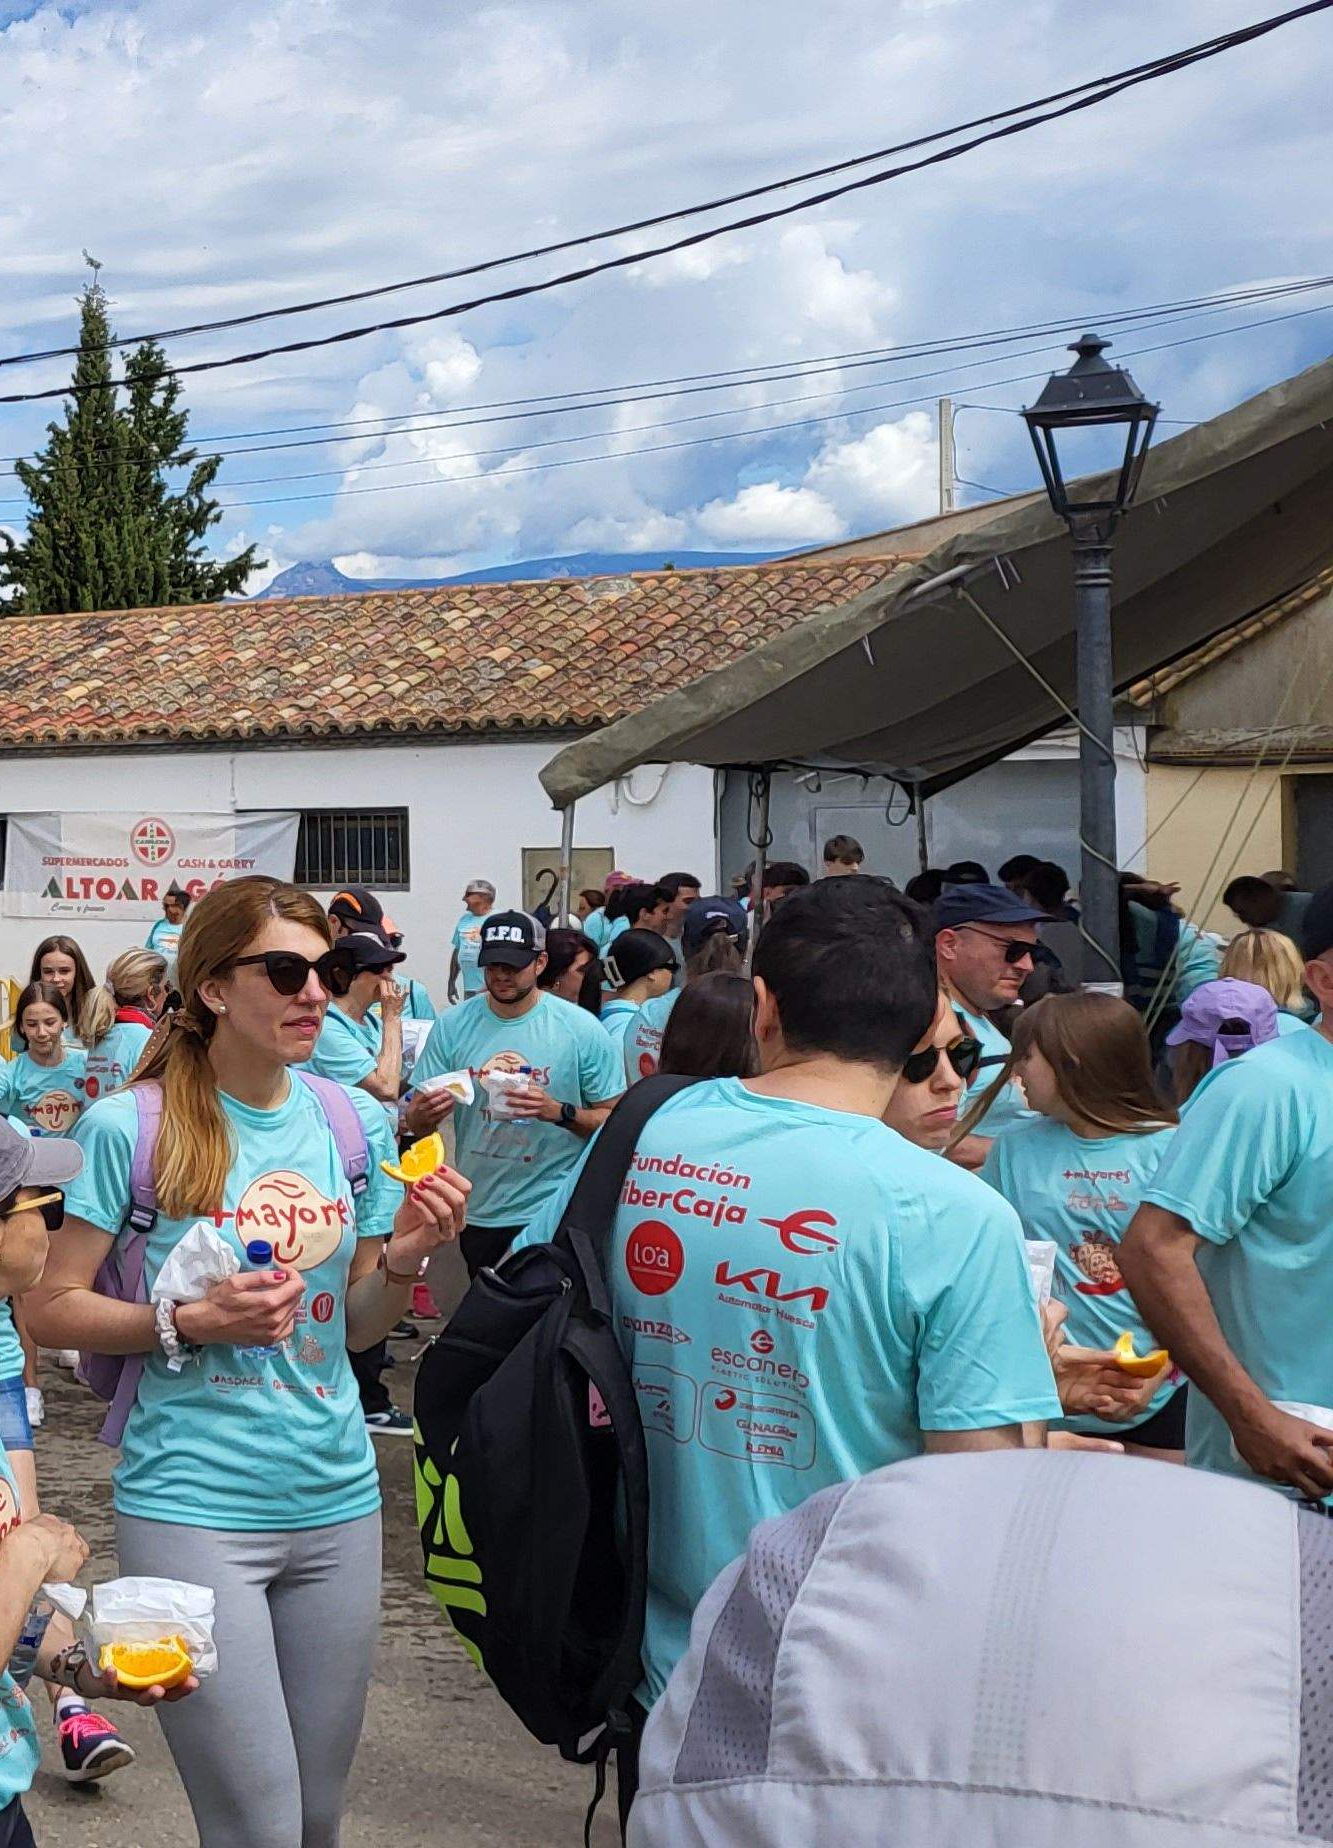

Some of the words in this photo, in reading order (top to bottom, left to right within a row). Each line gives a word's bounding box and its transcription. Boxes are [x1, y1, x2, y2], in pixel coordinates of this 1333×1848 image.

[41, 857, 130, 868] SUPERMERCADOS
[177, 858, 206, 869] CASH
[208, 859, 216, 869] &
[218, 858, 256, 869] CARRY
[41, 872, 227, 902] ALTOARAG
[207, 1197, 349, 1248] +mayore
